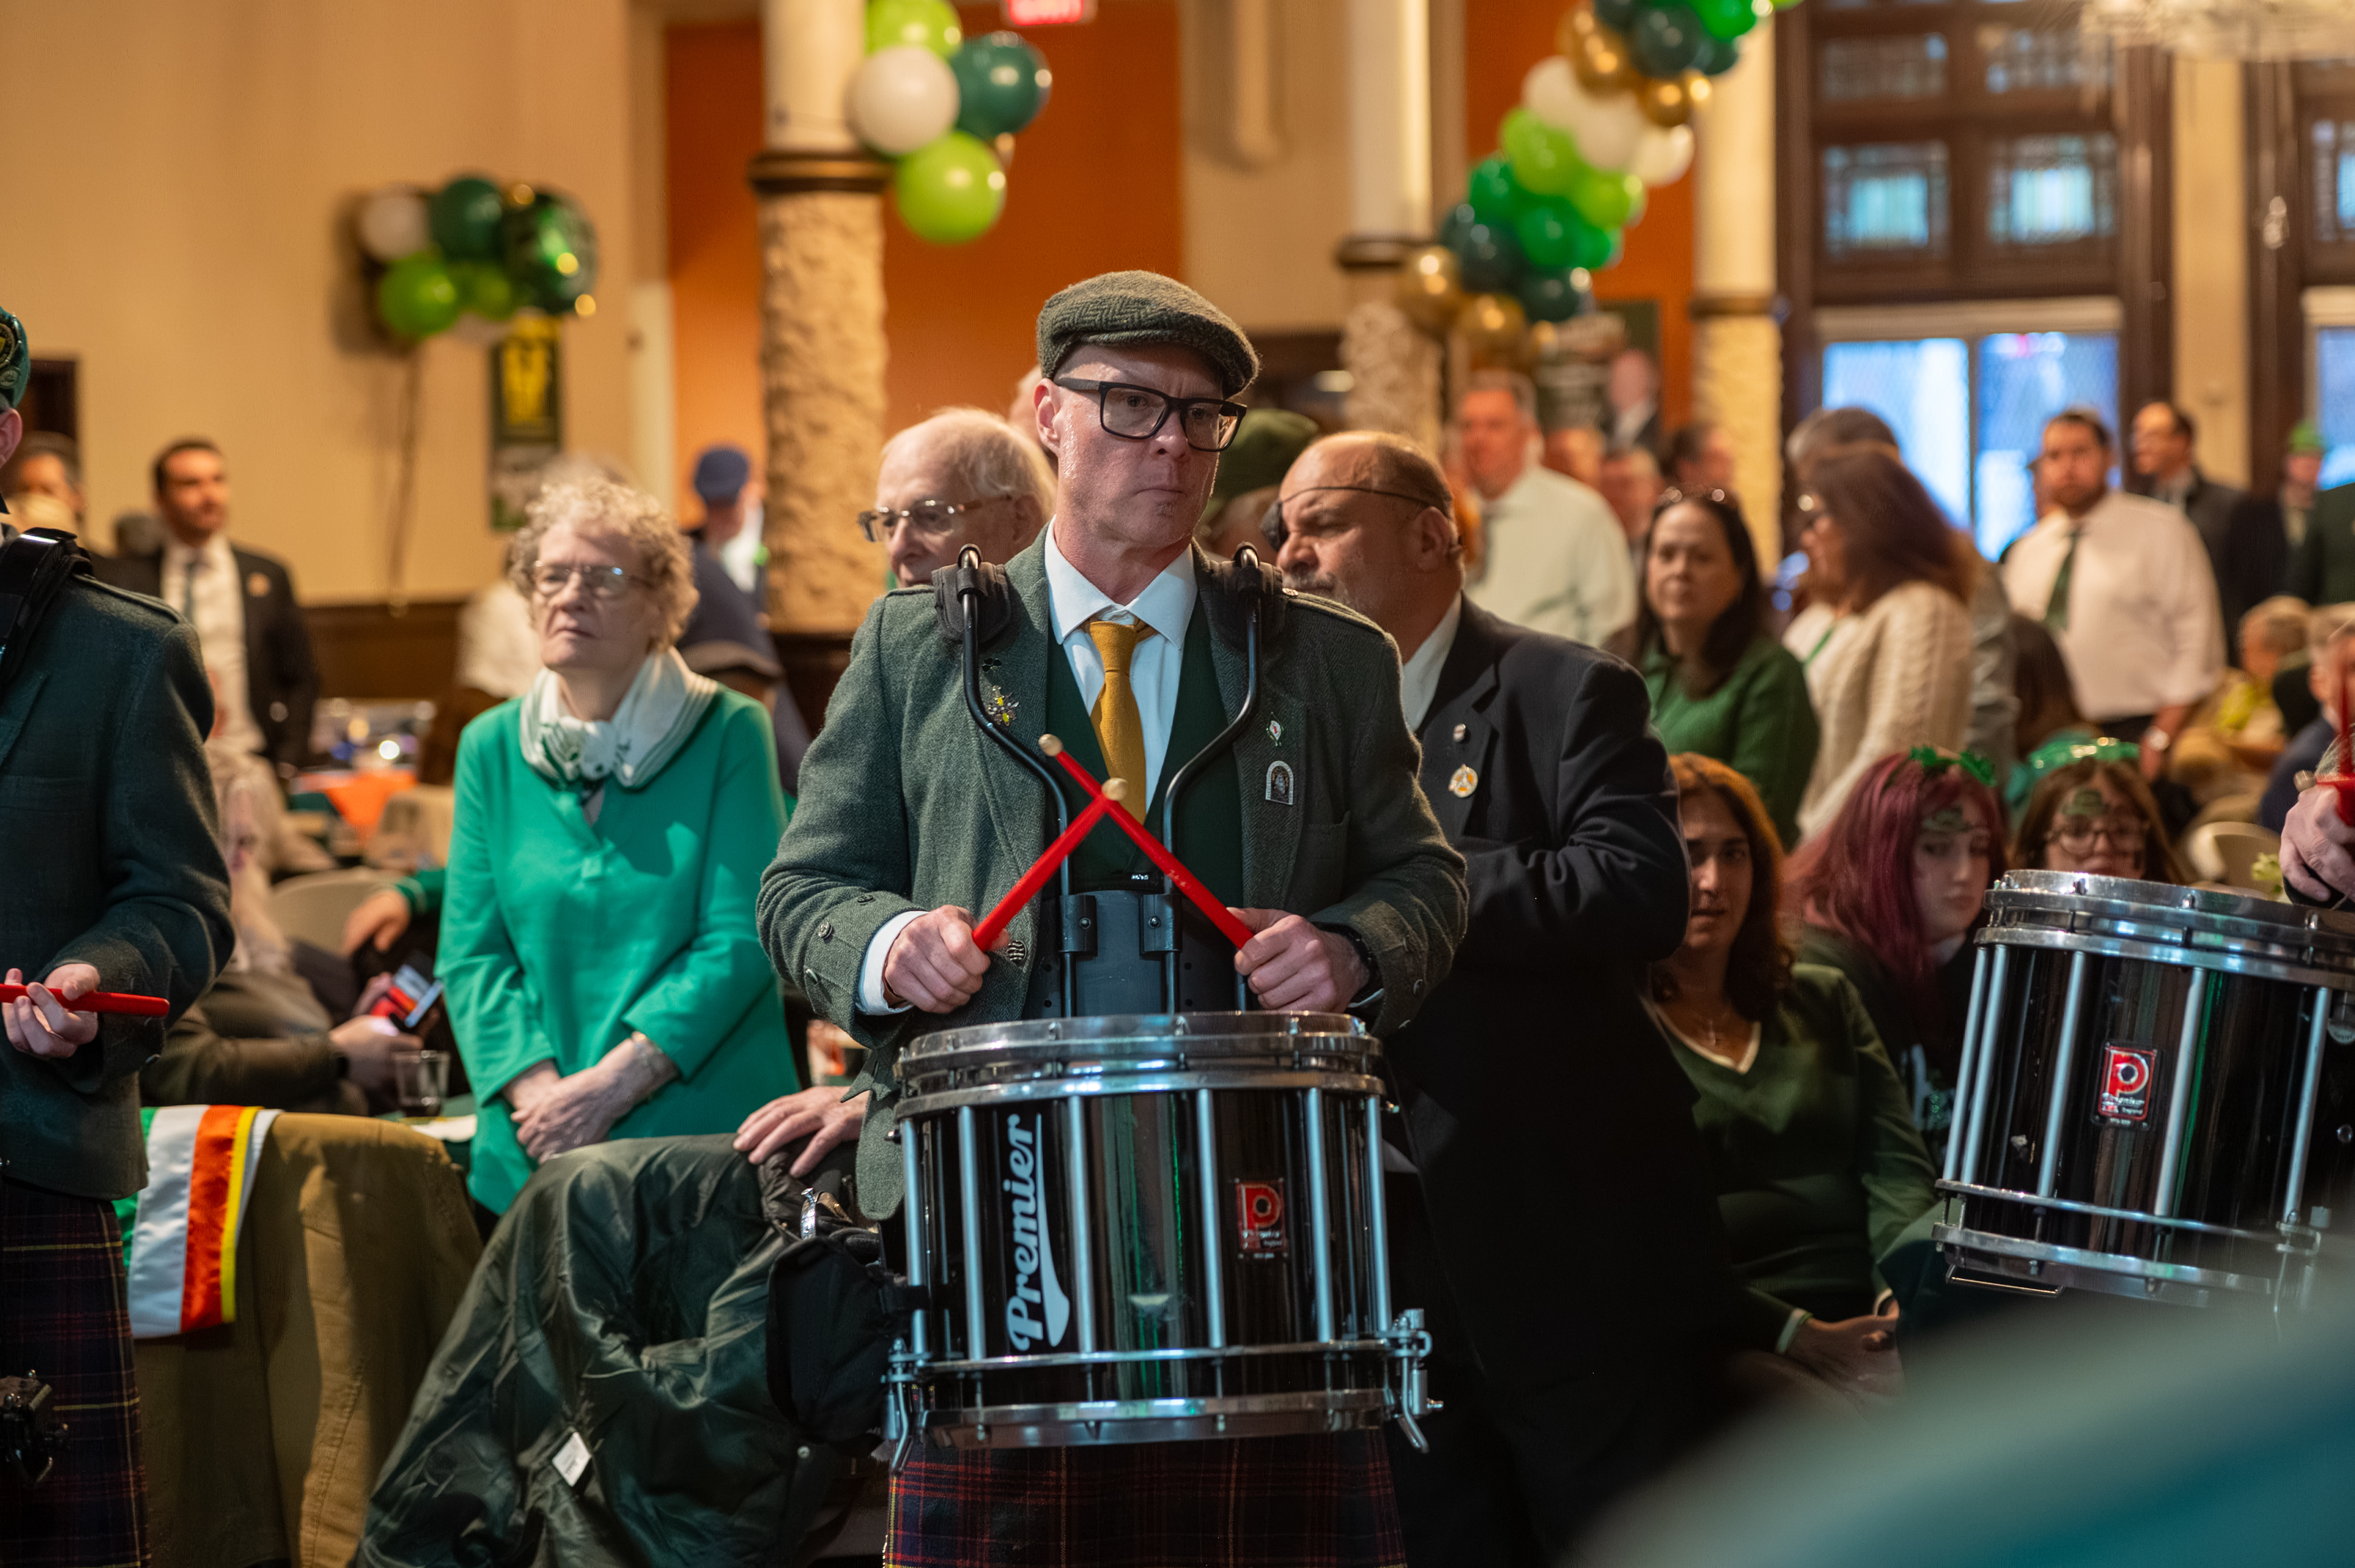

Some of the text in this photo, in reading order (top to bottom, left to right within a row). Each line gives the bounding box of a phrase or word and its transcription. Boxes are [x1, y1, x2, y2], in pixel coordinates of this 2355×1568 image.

[2106, 1049, 2150, 1098] P
[1003, 1113, 1044, 1351] Premier
[1240, 1184, 1281, 1231] P
